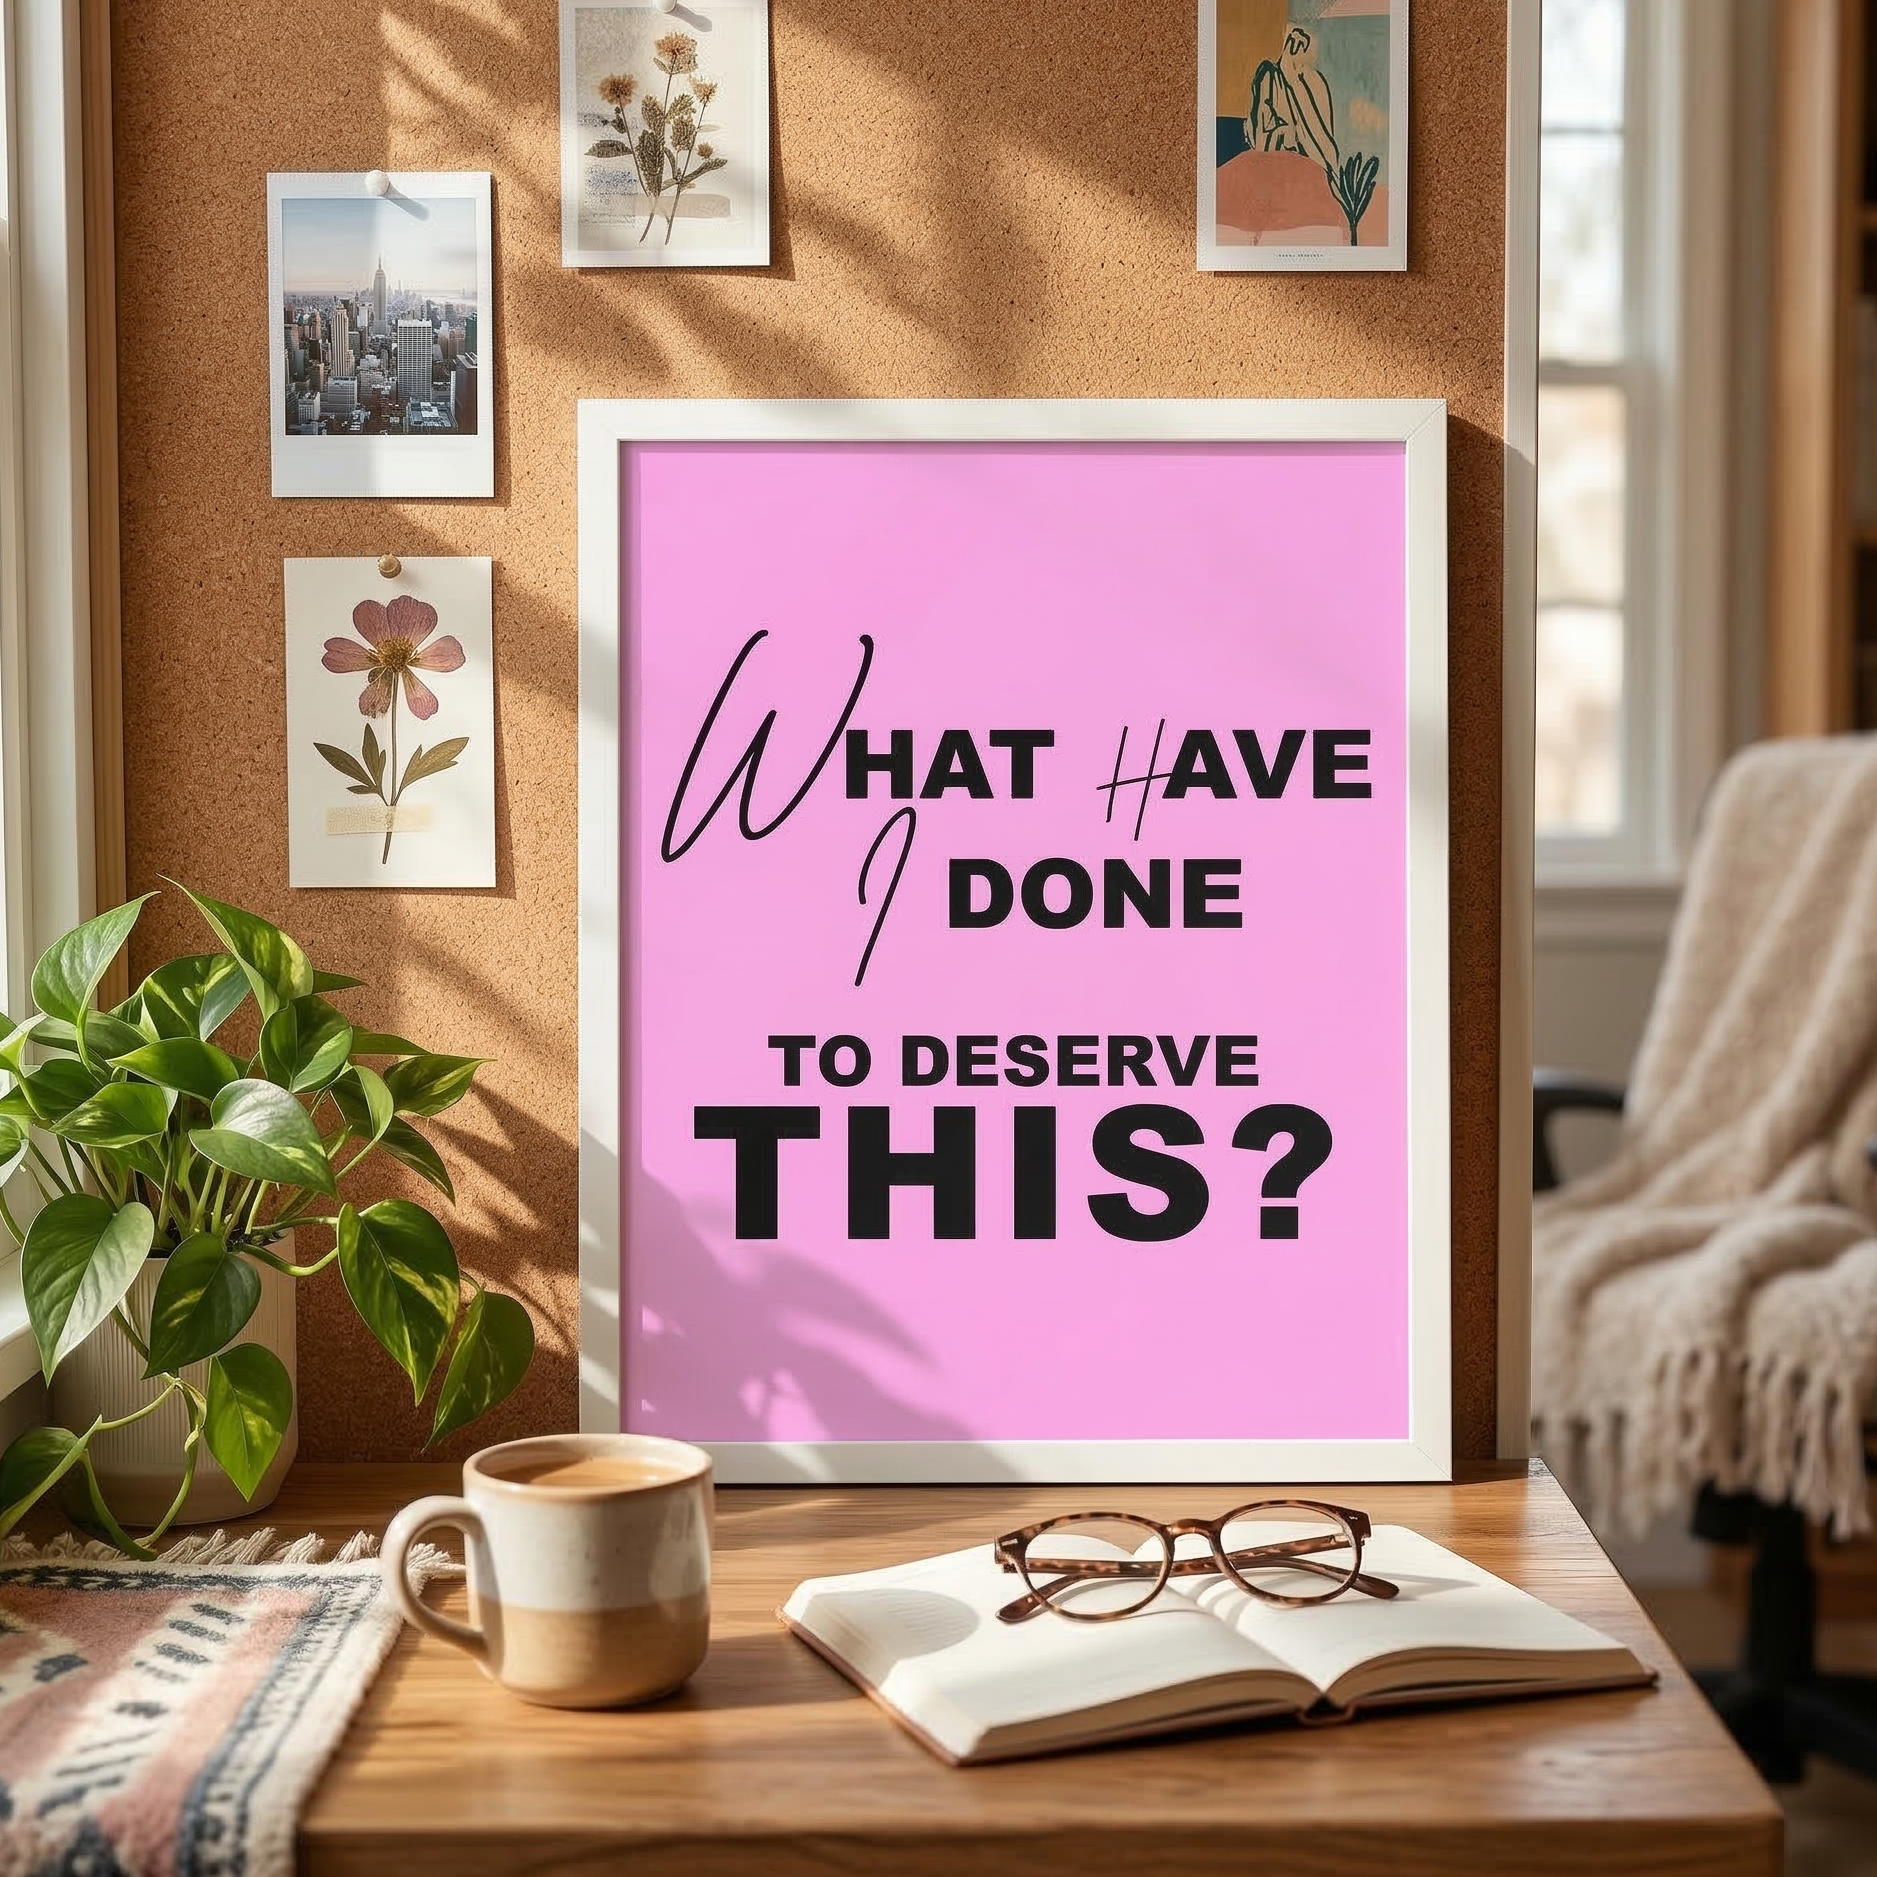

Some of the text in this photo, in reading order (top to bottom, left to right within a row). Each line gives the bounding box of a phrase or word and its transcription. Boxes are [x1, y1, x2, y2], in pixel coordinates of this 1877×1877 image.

[661, 629, 1372, 862] WHAT HAVE
[855, 806, 1243, 987] I DONE
[767, 1035, 1259, 1088] TO DESERVE
[693, 1104, 1333, 1241] THIS?
